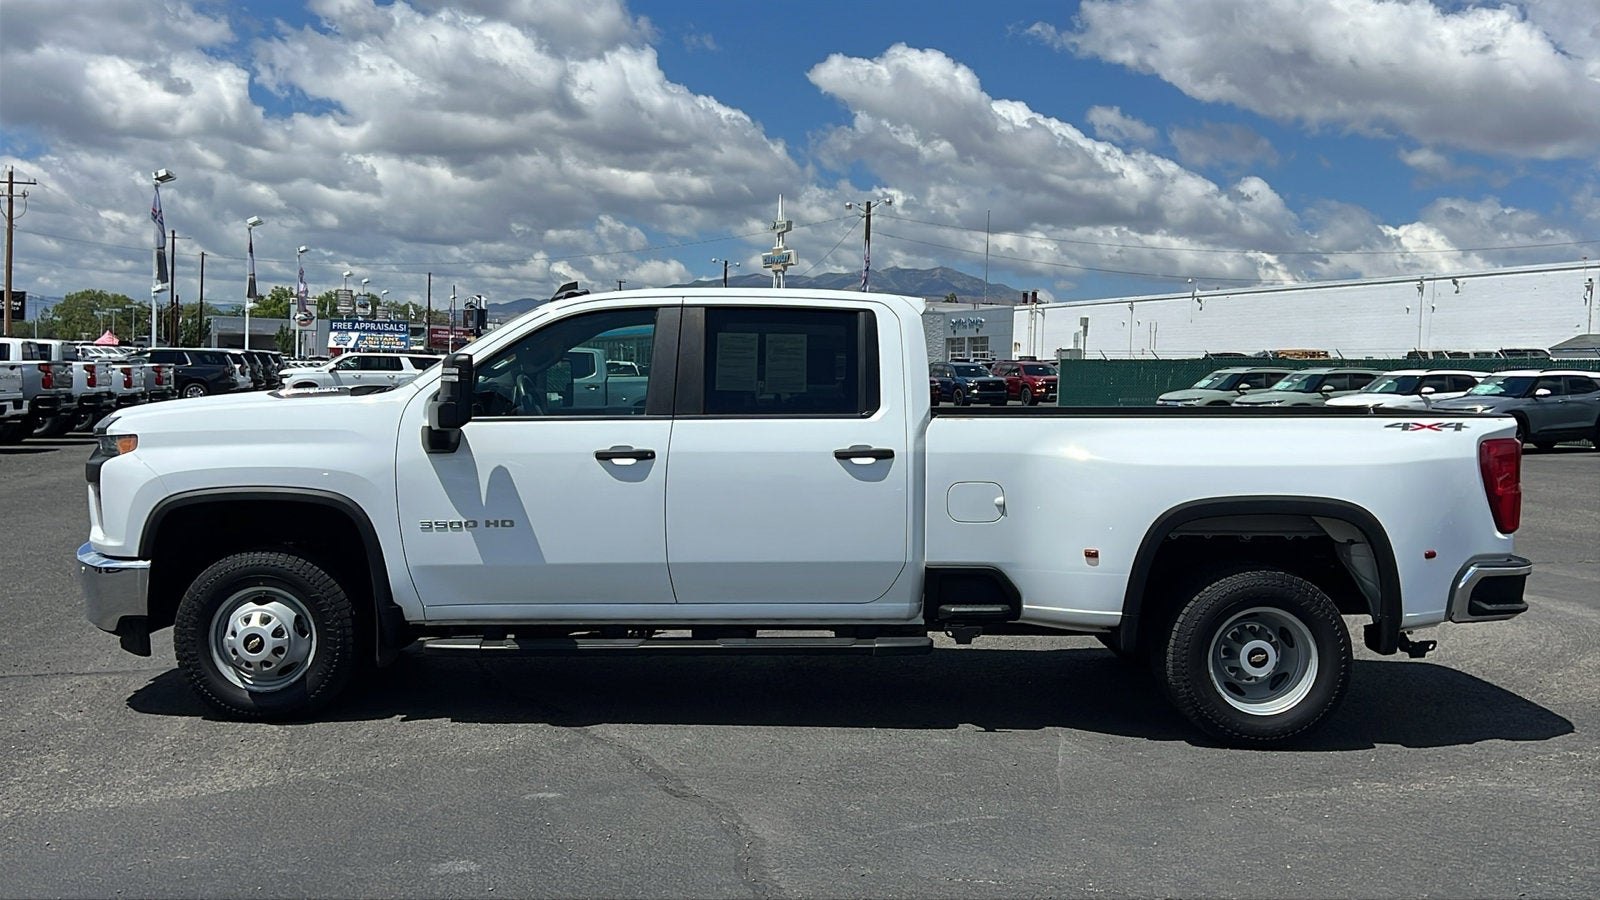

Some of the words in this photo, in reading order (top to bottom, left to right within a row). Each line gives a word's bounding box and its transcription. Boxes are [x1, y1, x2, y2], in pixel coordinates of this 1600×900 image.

[332, 322, 353, 330] FREE
[354, 322, 407, 331] APPRAISALS!
[419, 519, 478, 529] 3500
[485, 519, 515, 528] HD
